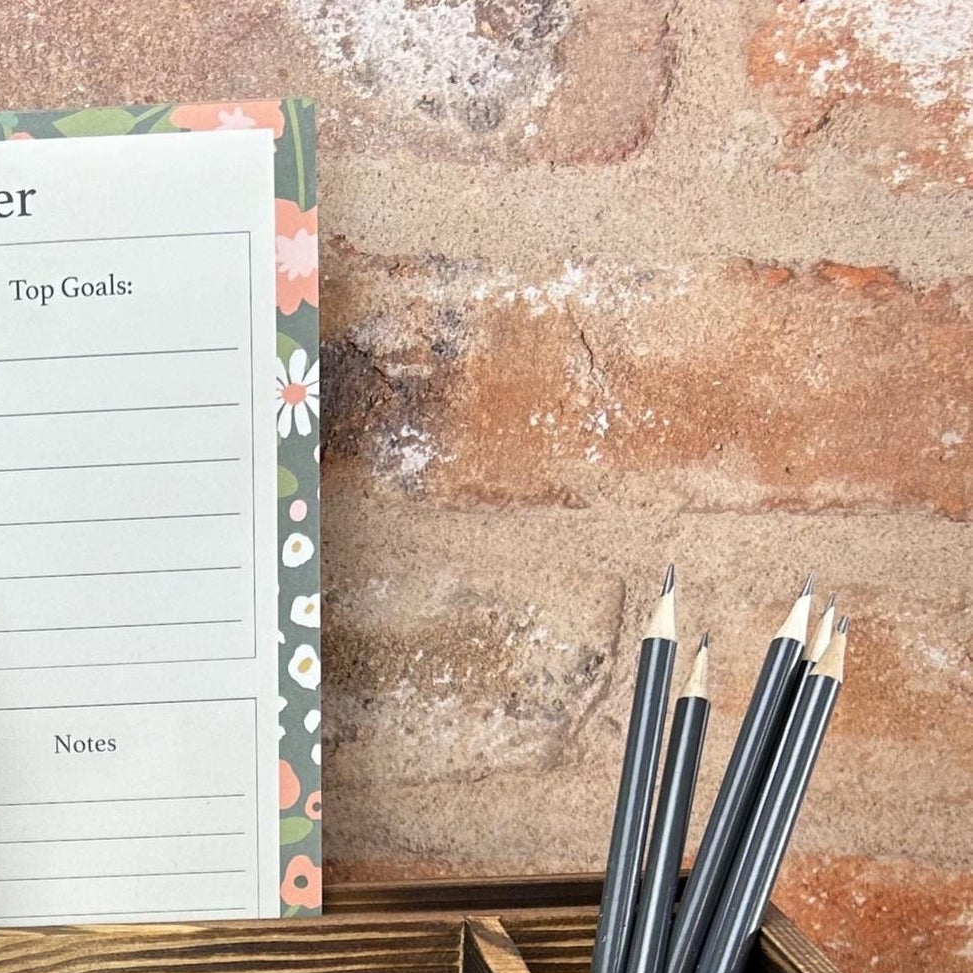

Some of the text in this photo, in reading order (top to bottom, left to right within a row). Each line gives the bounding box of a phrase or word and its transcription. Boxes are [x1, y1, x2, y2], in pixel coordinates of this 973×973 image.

[8, 273, 133, 307] Top Goals:
[54, 734, 117, 754] Notes
